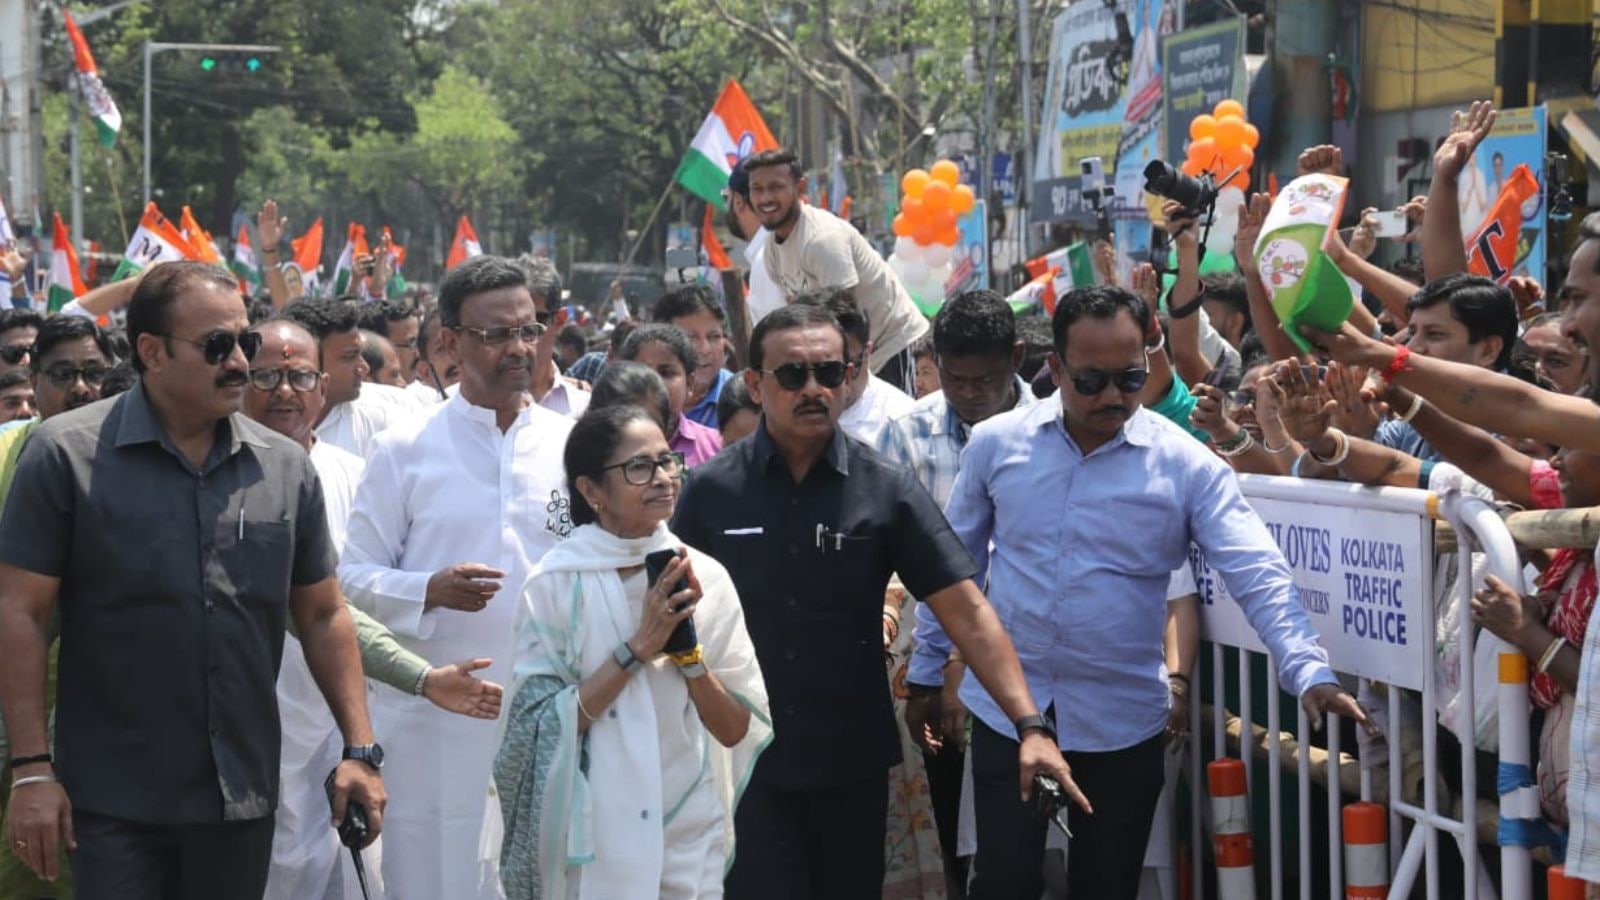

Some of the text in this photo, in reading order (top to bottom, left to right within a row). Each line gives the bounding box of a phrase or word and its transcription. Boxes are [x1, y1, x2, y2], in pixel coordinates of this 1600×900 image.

[1266, 522, 1331, 574] LOVES
[1340, 537, 1404, 573] KOLKATA
[1344, 572, 1403, 609] TRAFFIC
[1342, 604, 1407, 645] POLICE
